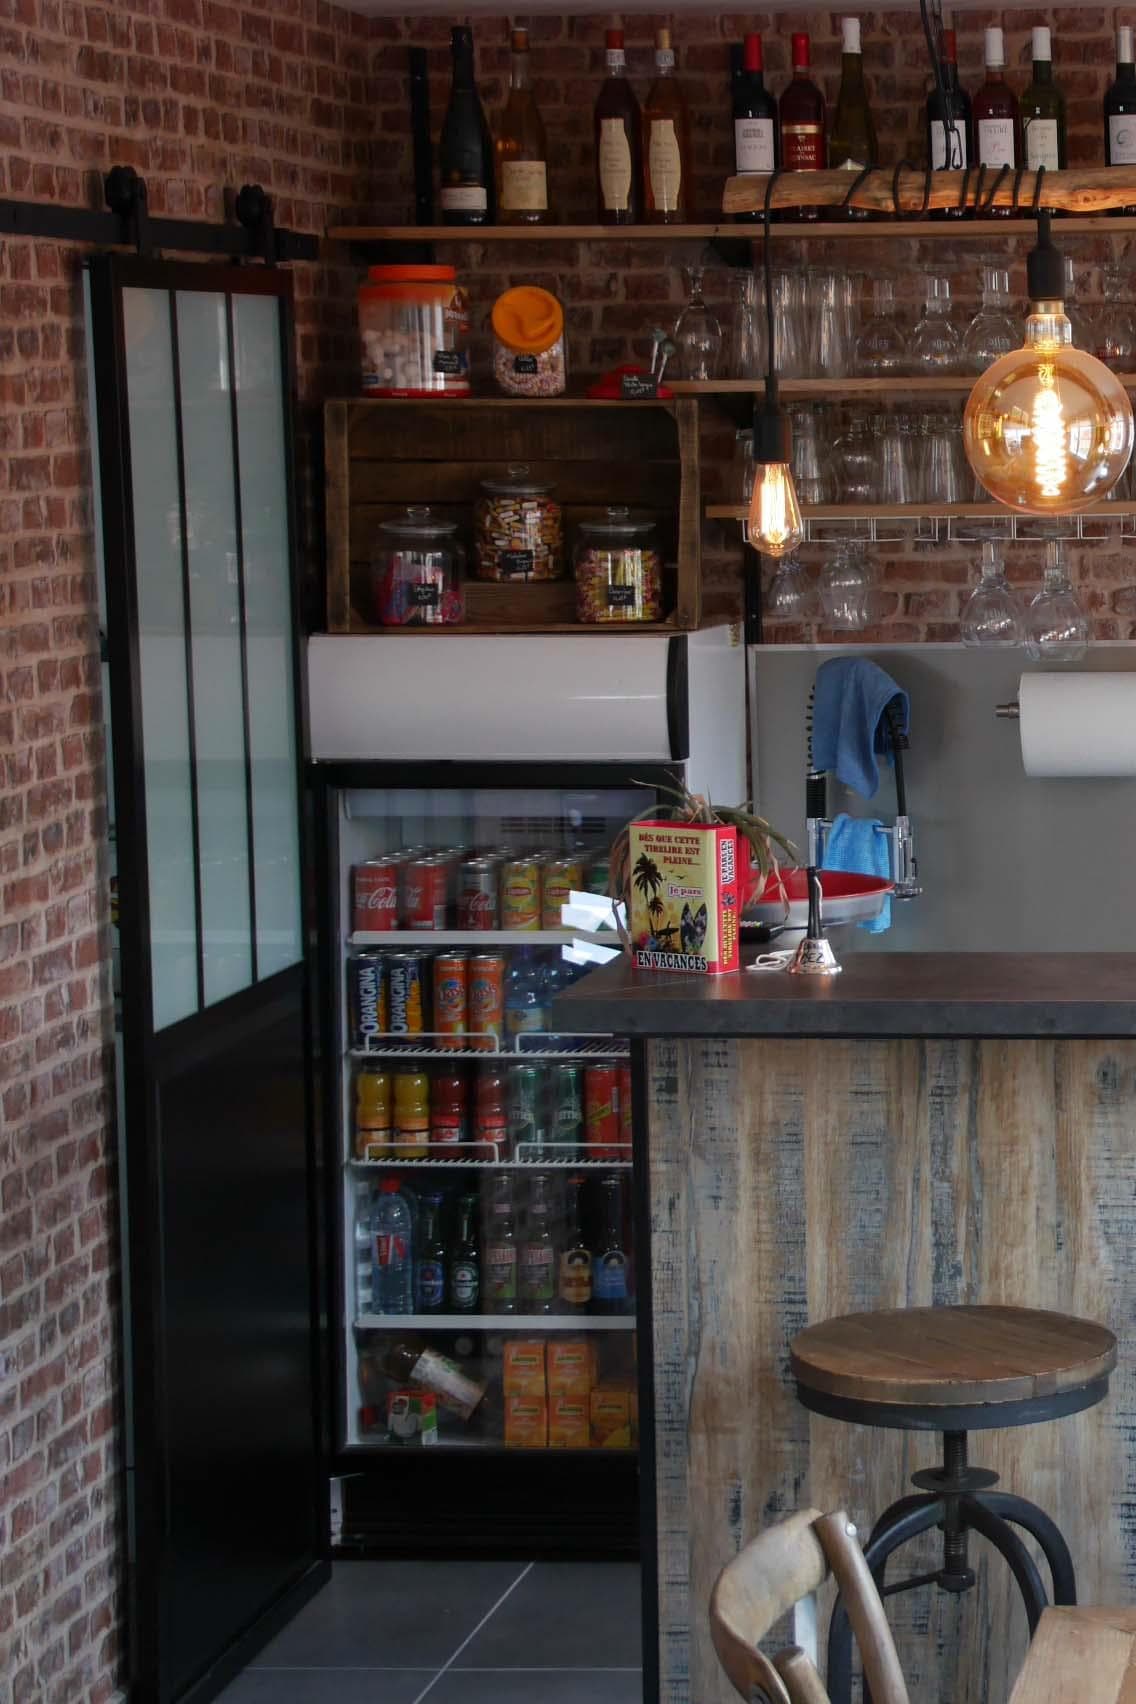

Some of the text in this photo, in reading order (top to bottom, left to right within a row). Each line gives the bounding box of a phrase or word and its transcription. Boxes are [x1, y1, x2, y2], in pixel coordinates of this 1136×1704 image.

[656, 834, 673, 844] QUE
[675, 836, 701, 845] CETTE
[644, 844, 701, 856] TIRELIRE EST
[671, 887, 701, 896] Je pars
[638, 952, 707, 971] EN VACANCES
[359, 966, 380, 1034] ORANGINA
[390, 967, 409, 1033] ORANGINA
